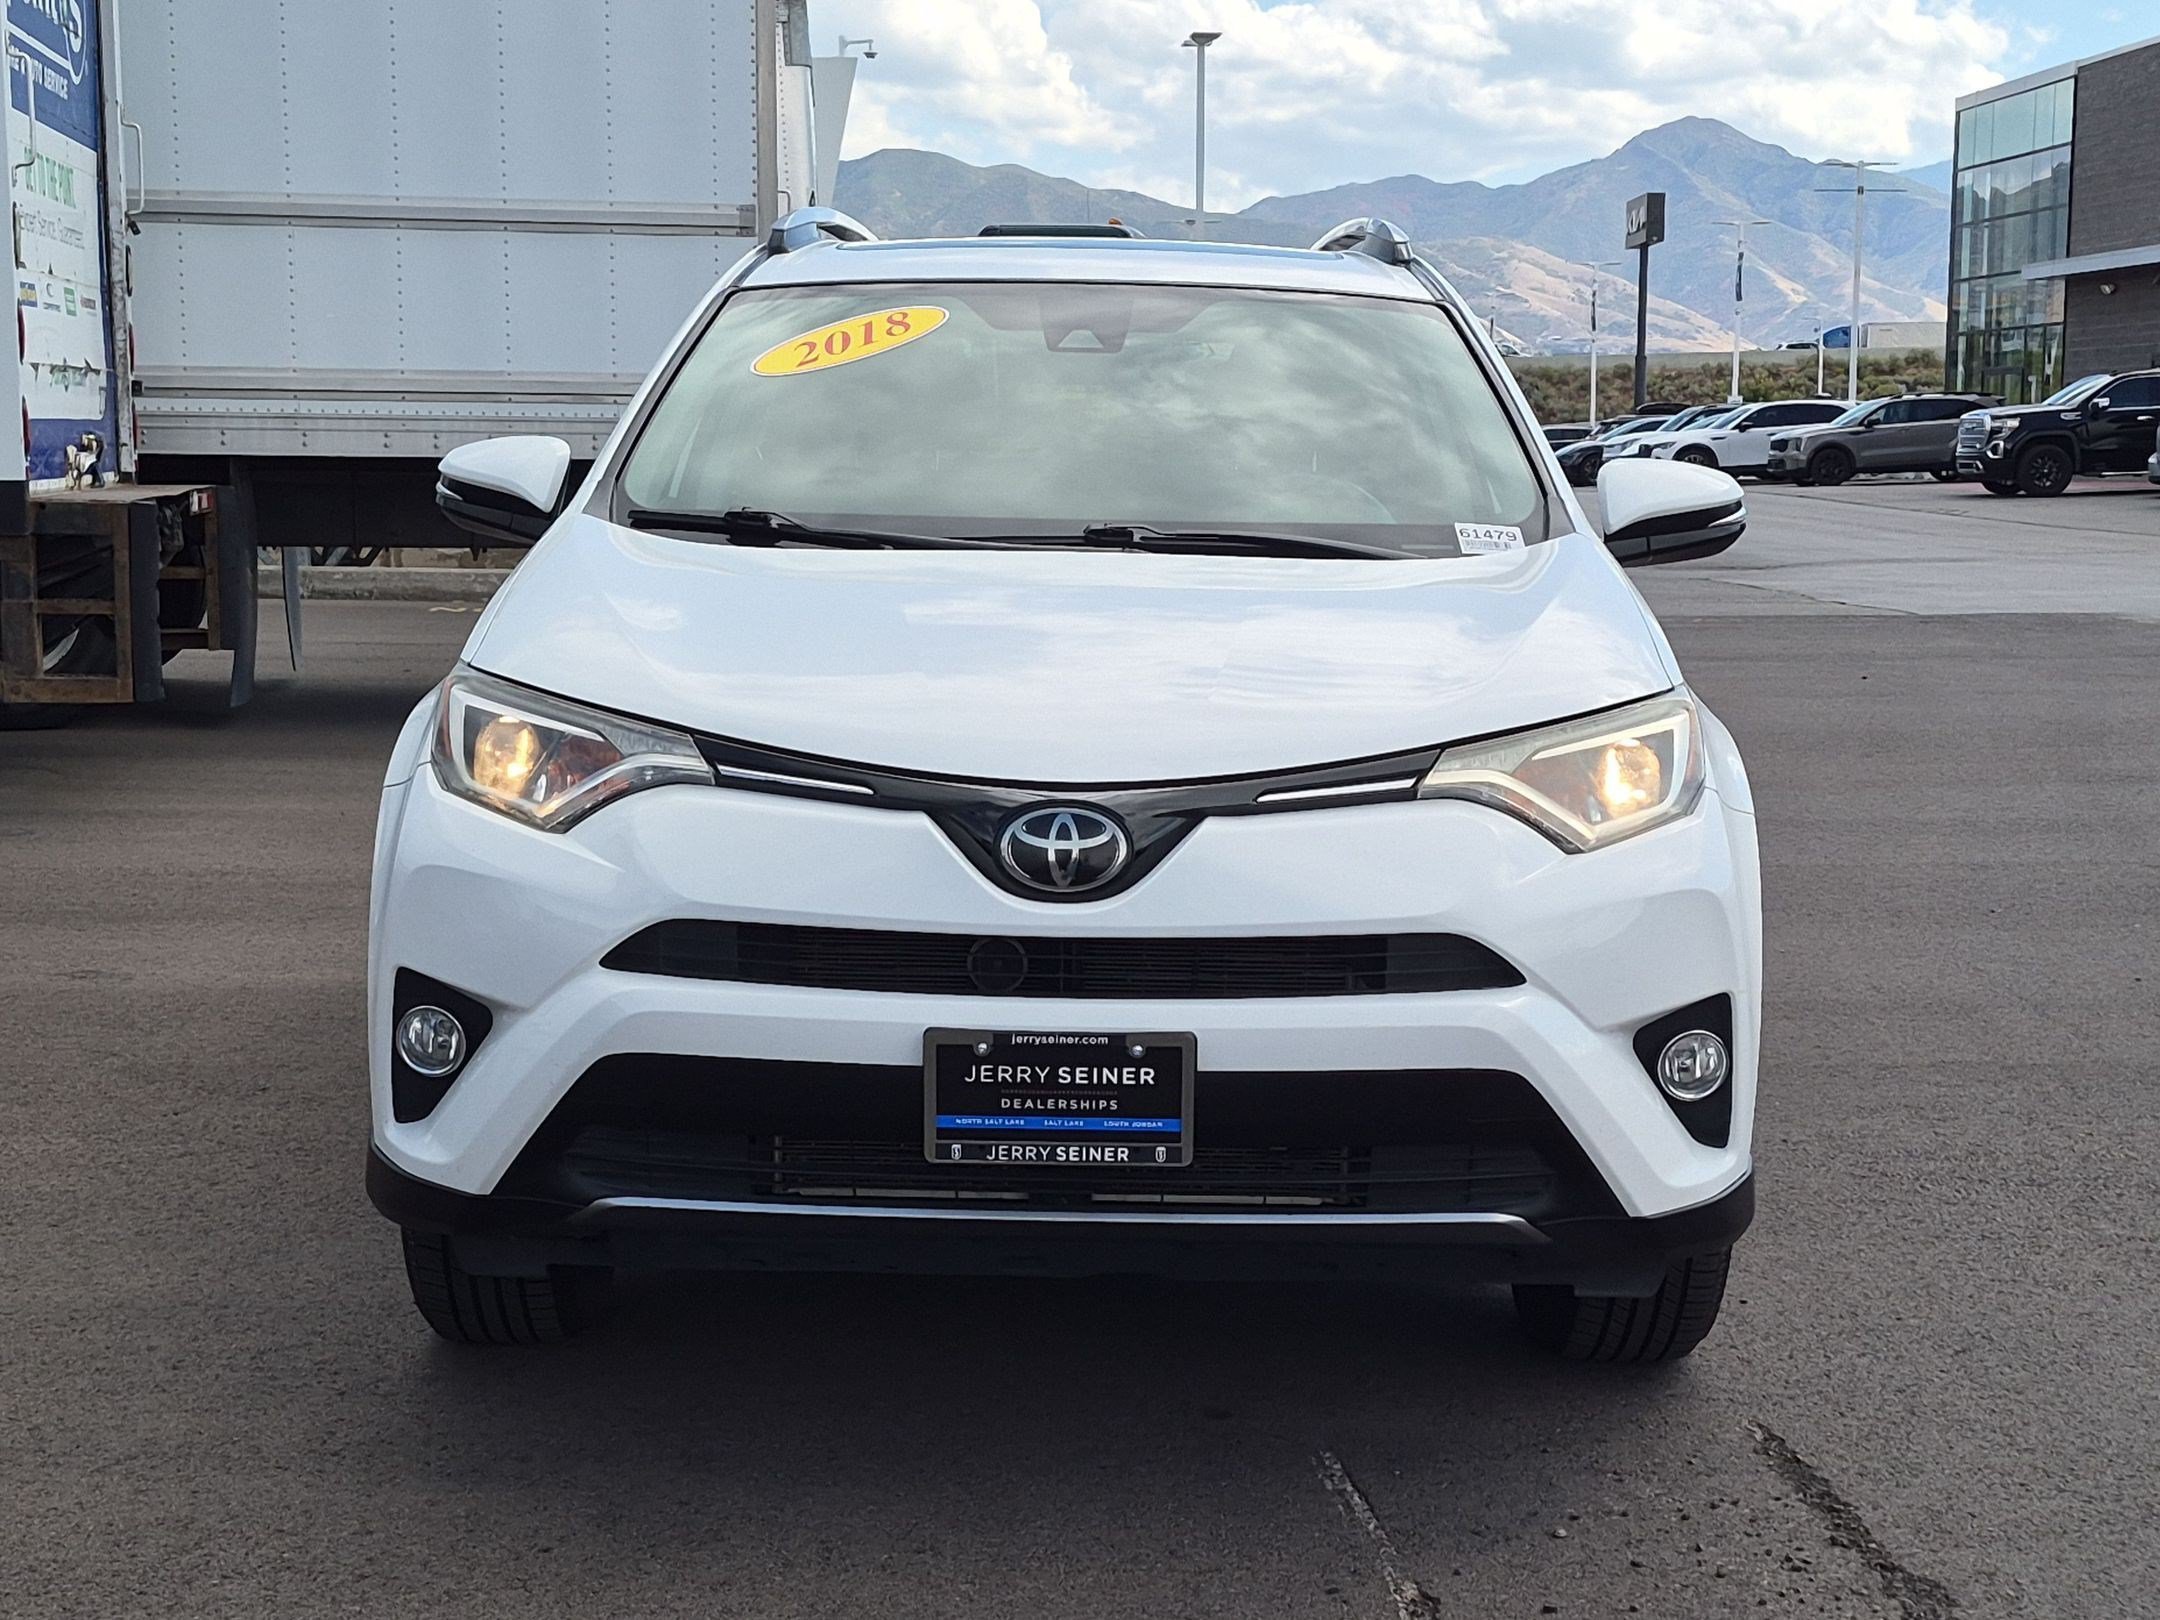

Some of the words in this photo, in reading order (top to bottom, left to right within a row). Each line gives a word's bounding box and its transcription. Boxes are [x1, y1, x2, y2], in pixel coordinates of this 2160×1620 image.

[794, 312, 911, 368] 2018
[1459, 528, 1517, 541] 61479
[1011, 1033, 1109, 1045] jerryseiner.com
[964, 1065, 1051, 1084] JERRY
[1058, 1066, 1156, 1085] SEINER
[1001, 1098, 1118, 1110] DEALERSHIPS
[1064, 1119, 1084, 1127] LAKE
[986, 1145, 1051, 1161] JERRY
[1056, 1146, 1129, 1162] SEINER
